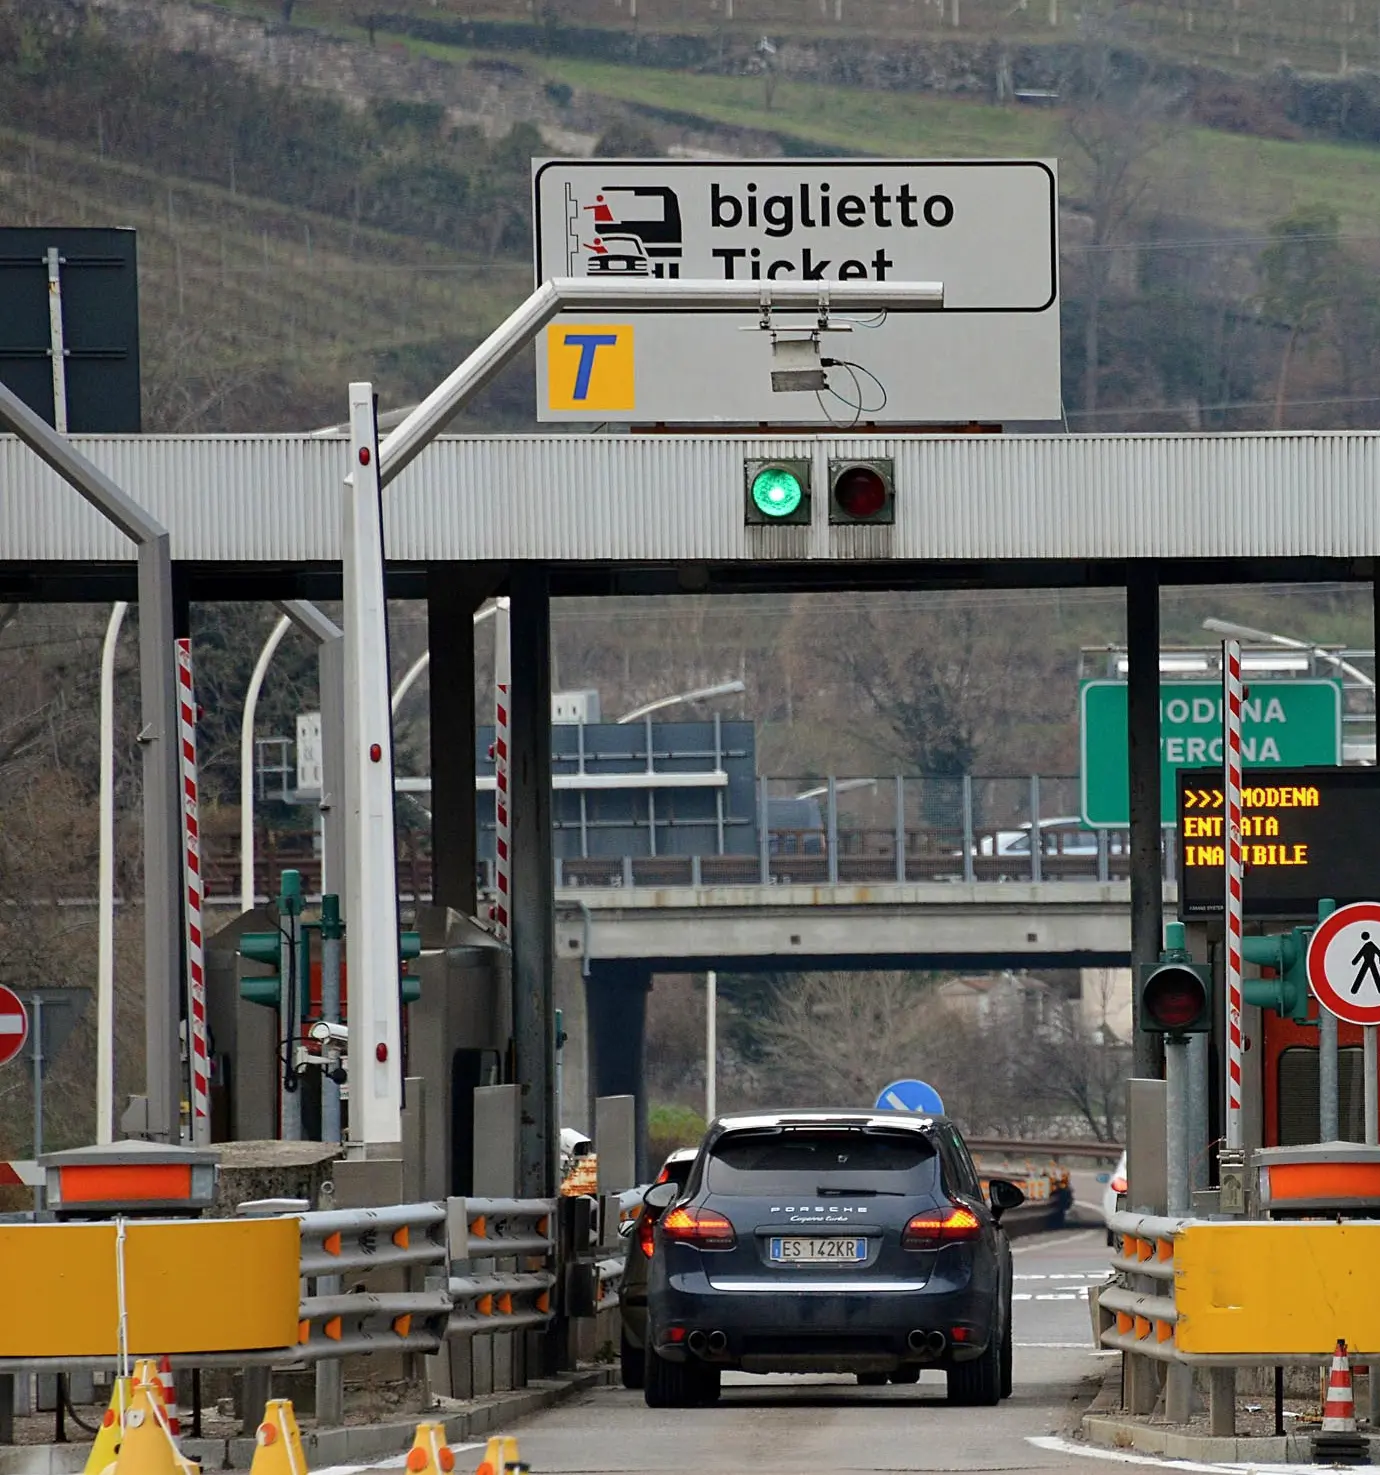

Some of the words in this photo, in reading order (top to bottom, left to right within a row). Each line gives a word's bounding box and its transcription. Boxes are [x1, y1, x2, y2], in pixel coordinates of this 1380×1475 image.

[711, 183, 954, 237] biglietto
[564, 335, 617, 400] T
[1160, 698, 1287, 723] ODNA
[1160, 737, 1281, 762] ERONA
[1240, 787, 1319, 807] MODENA
[1184, 816, 1279, 837] ENTATA
[1185, 845, 1308, 866] INAIBILE
[783, 1241, 801, 1257] ES
[809, 1241, 855, 1257] 142KR
